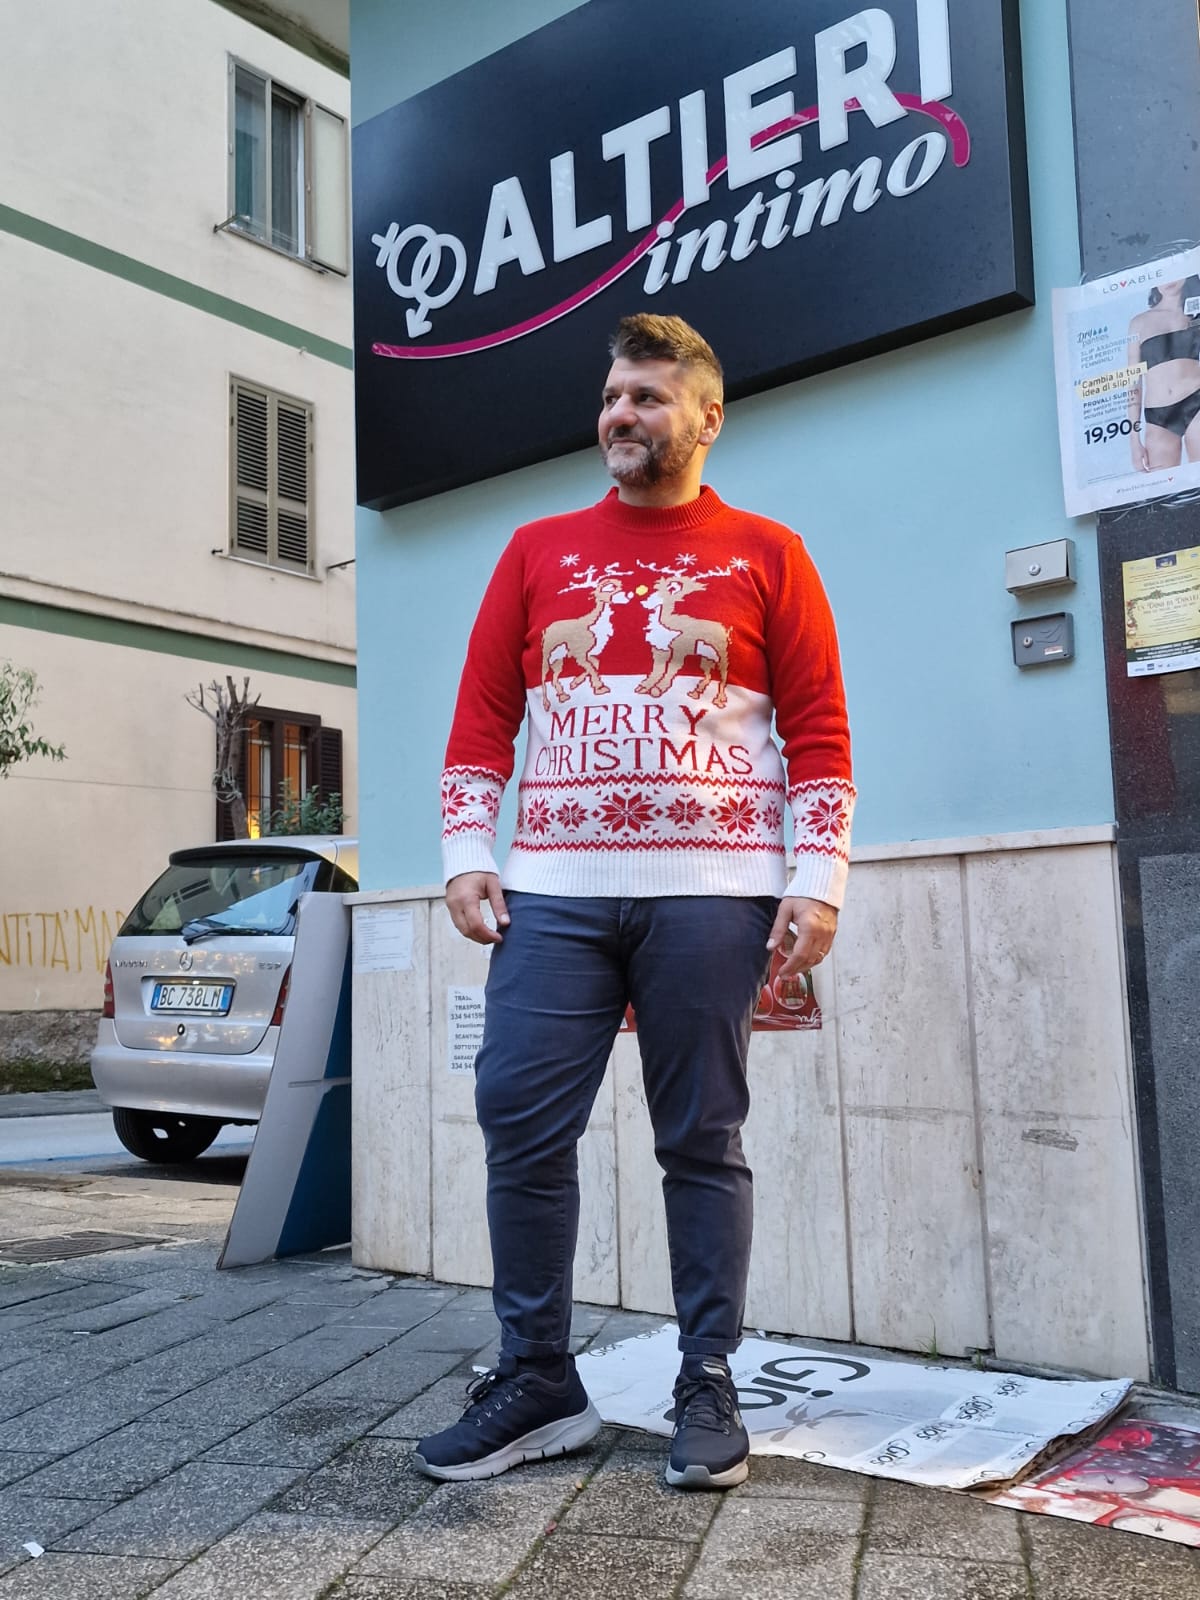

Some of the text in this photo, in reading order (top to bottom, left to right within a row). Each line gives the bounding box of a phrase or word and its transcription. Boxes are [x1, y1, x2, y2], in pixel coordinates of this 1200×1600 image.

[473, 0, 953, 295] ALTIERI
[642, 131, 948, 295] intimo
[1102, 269, 1163, 294] LOVABLE
[1082, 366, 1142, 389] Cambia la tua
[1082, 385, 1101, 398] idea
[1102, 381, 1110, 392] di
[1083, 388, 1140, 408] PROVALI SUBITO
[1084, 419, 1142, 445] 19,90€
[550, 703, 709, 741] MERRY
[535, 737, 753, 776] CHRISTMAS
[177, 985, 222, 1008] 738LM
